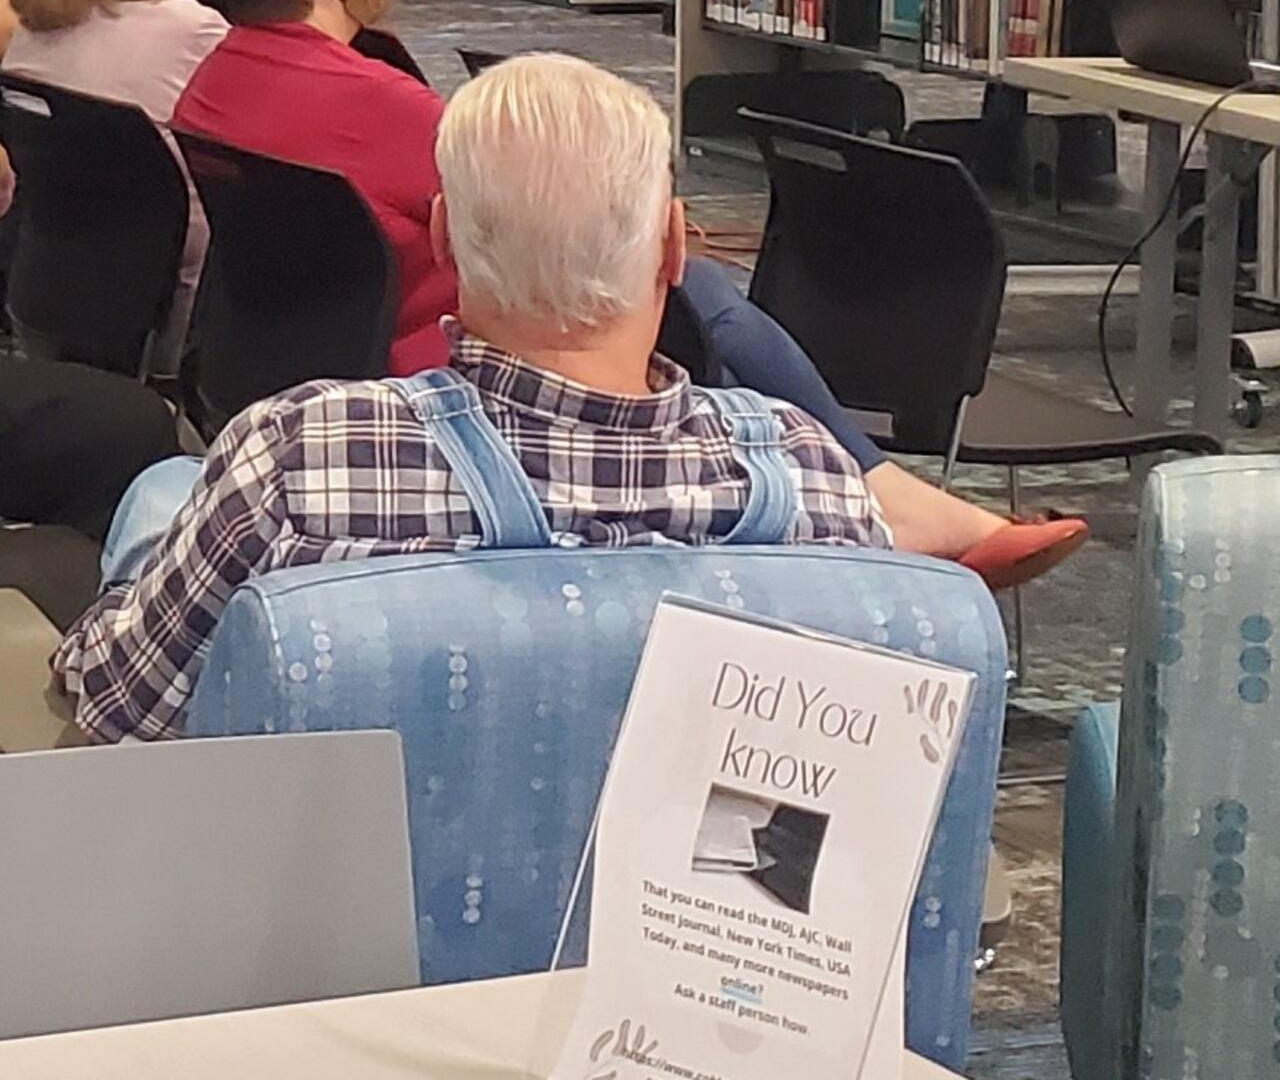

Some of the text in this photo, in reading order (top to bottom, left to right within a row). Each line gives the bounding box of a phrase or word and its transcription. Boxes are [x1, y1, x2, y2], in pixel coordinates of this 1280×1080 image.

[712, 662, 877, 746] Did You
[720, 727, 837, 798] know
[641, 903, 676, 924] Street
[726, 928, 753, 947] New
[757, 937, 783, 956] York
[827, 958, 852, 977] USA
[642, 880, 668, 898] That
[670, 891, 692, 905] you
[694, 897, 715, 912] can
[718, 904, 745, 921] read
[747, 911, 768, 927] the
[825, 934, 852, 953] Wall
[642, 926, 849, 1001] Today, and many more newspapers
[720, 975, 764, 995] online?
[674, 983, 695, 1000] Ask
[698, 992, 706, 1003] a
[708, 994, 737, 1012] staff
[738, 1005, 779, 1025] person
